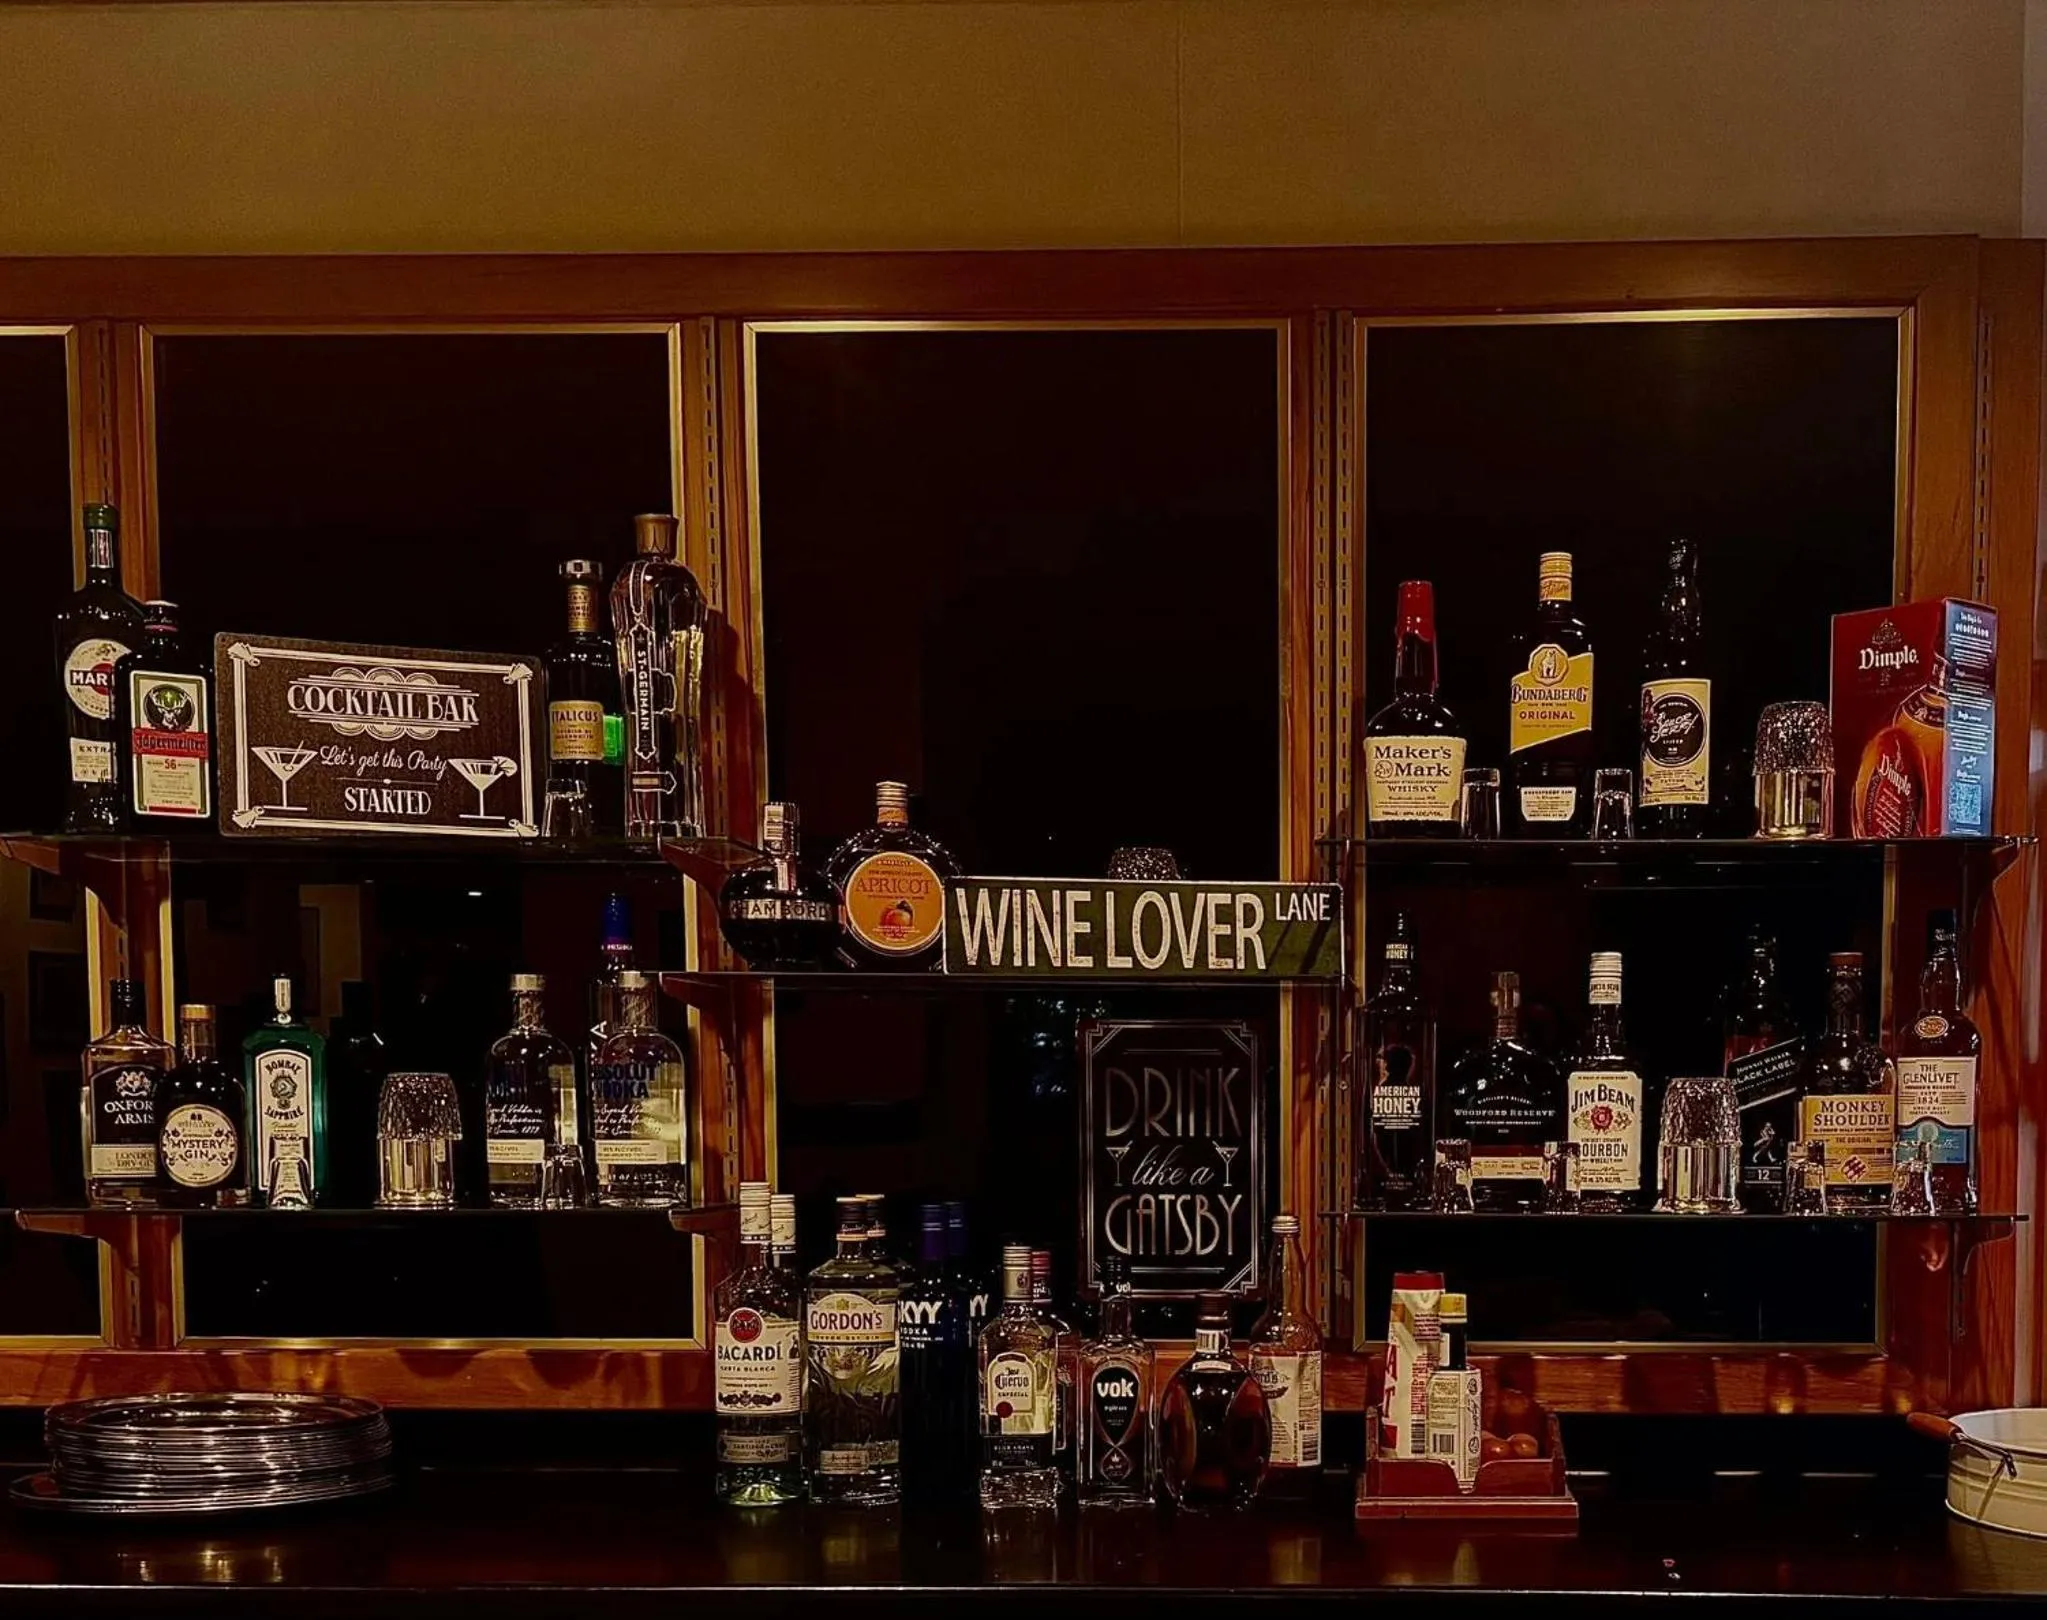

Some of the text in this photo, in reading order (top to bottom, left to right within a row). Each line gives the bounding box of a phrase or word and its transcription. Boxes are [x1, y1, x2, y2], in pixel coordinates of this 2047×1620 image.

[71, 671, 109, 686] MAR
[1511, 684, 1589, 704] BUNDABERG
[287, 684, 480, 722] COCKTAIL BAR
[552, 711, 598, 722] ITALICUS
[1520, 711, 1576, 720] ORIGINAL
[1374, 746, 1452, 759] Maker's
[164, 759, 177, 770] 56
[319, 745, 448, 781] Let's get this Party
[1879, 753, 1912, 796] Dimple
[1387, 785, 1438, 793] WHISKY
[344, 786, 432, 816] STARTED
[856, 878, 932, 895] APRICOT
[730, 900, 830, 918] CHAMBORD
[955, 887, 1331, 971] WINE LOVER LANE
[1386, 950, 1409, 959] HONEY
[265, 1060, 302, 1075] BOMBAY
[1764, 1059, 1797, 1075] LABEL
[1920, 1064, 1938, 1072] THE
[1903, 1073, 1960, 1085] GLENLIVET
[1373, 1086, 1420, 1096] AMERICAN
[1571, 1083, 1635, 1113] JIM BEAM
[103, 1100, 155, 1113] OXFOR
[1104, 1066, 1243, 1138] DRINK
[1373, 1098, 1421, 1114] HONEY
[1820, 1101, 1886, 1113] MONKEY
[264, 1105, 304, 1120] SAPPHIRE
[1454, 1109, 1557, 1117] WOODFORD RESERVE
[1814, 1114, 1890, 1126] SHOULDER
[171, 1138, 224, 1149] MYSTERY
[115, 1152, 155, 1160] LONDO
[185, 1150, 209, 1159] GIN
[1131, 1143, 1215, 1186] like a
[1757, 1169, 1770, 1181] 12
[1103, 1193, 1243, 1256] GATSBY
[1115, 1282, 1131, 1293] vo
[810, 1309, 883, 1330] GORDON'S
[900, 1300, 943, 1325] KYY
[717, 1342, 784, 1361] BACARDÍ
[995, 1374, 1030, 1389] Cuervo
[1096, 1378, 1135, 1399] vok
